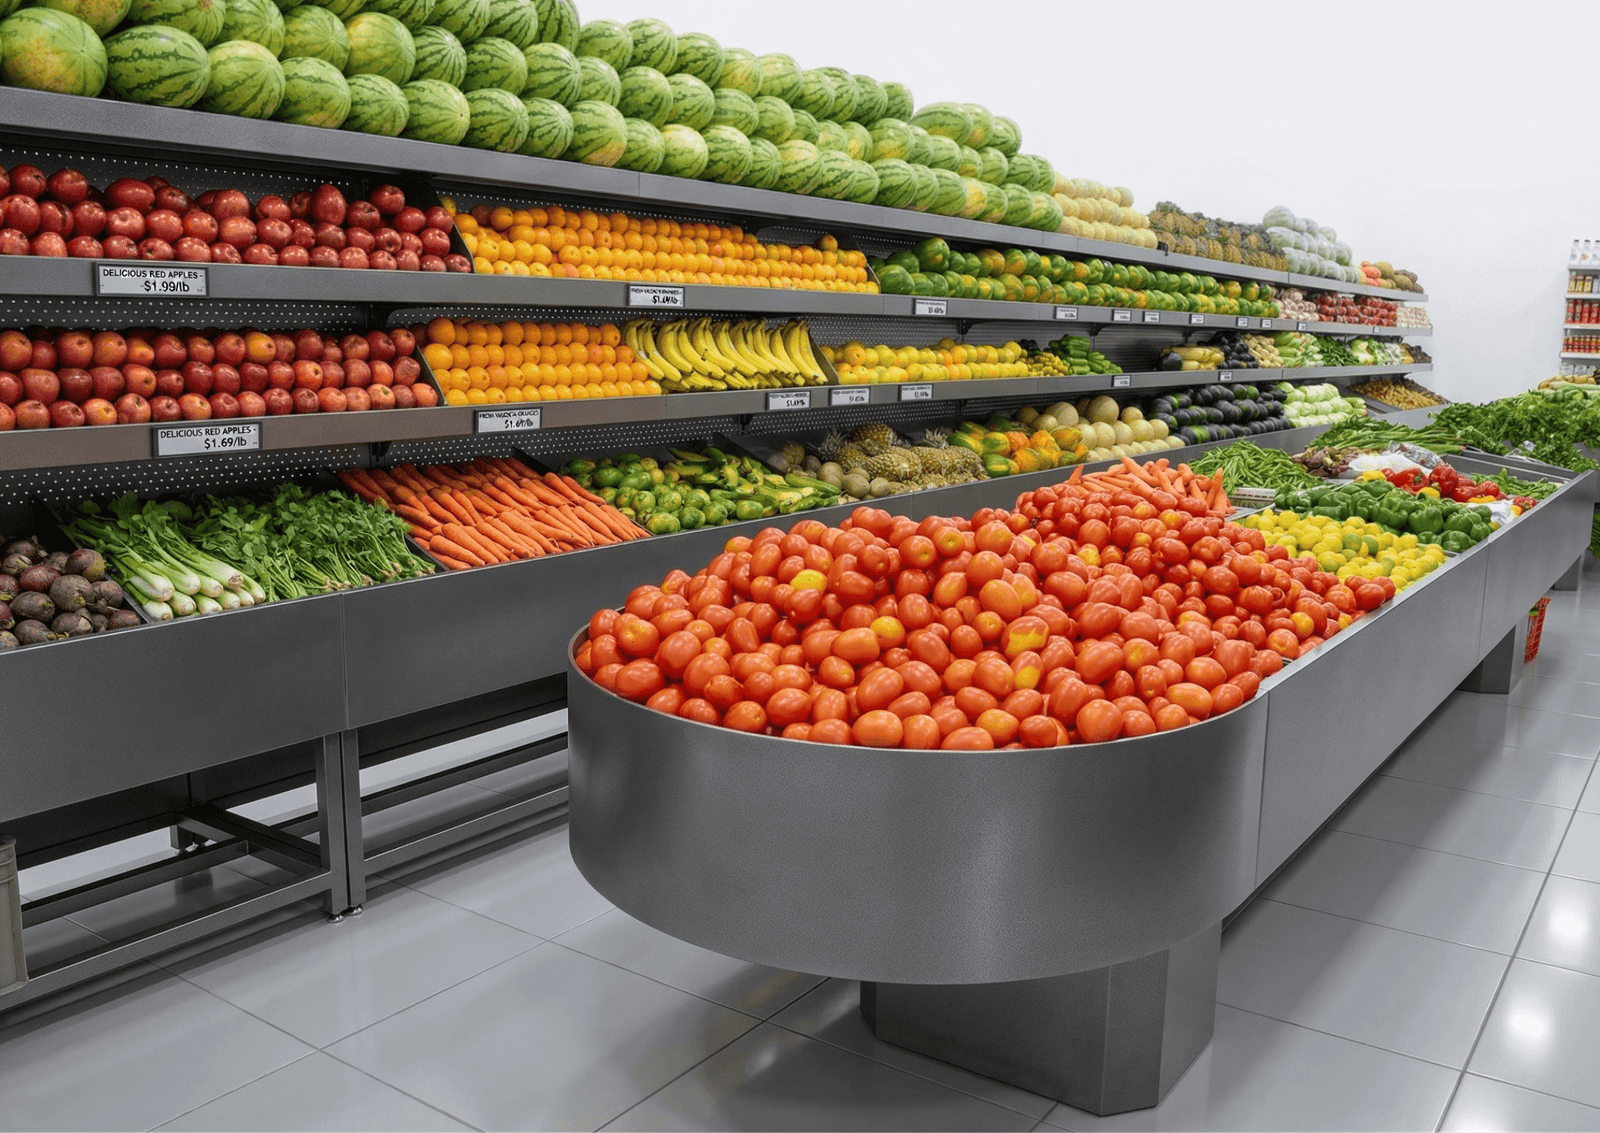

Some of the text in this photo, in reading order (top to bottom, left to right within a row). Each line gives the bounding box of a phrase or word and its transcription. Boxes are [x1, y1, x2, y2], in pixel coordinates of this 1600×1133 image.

[103, 269, 147, 278] DELICIOUS
[149, 270, 166, 279] RED
[168, 271, 198, 280] APPLES
[144, 280, 190, 293] $1.99/lb
[160, 428, 203, 439] DELICIOUS
[205, 427, 220, 436] RED
[222, 426, 252, 435] APPLES
[204, 436, 247, 450] $1.69/lb
